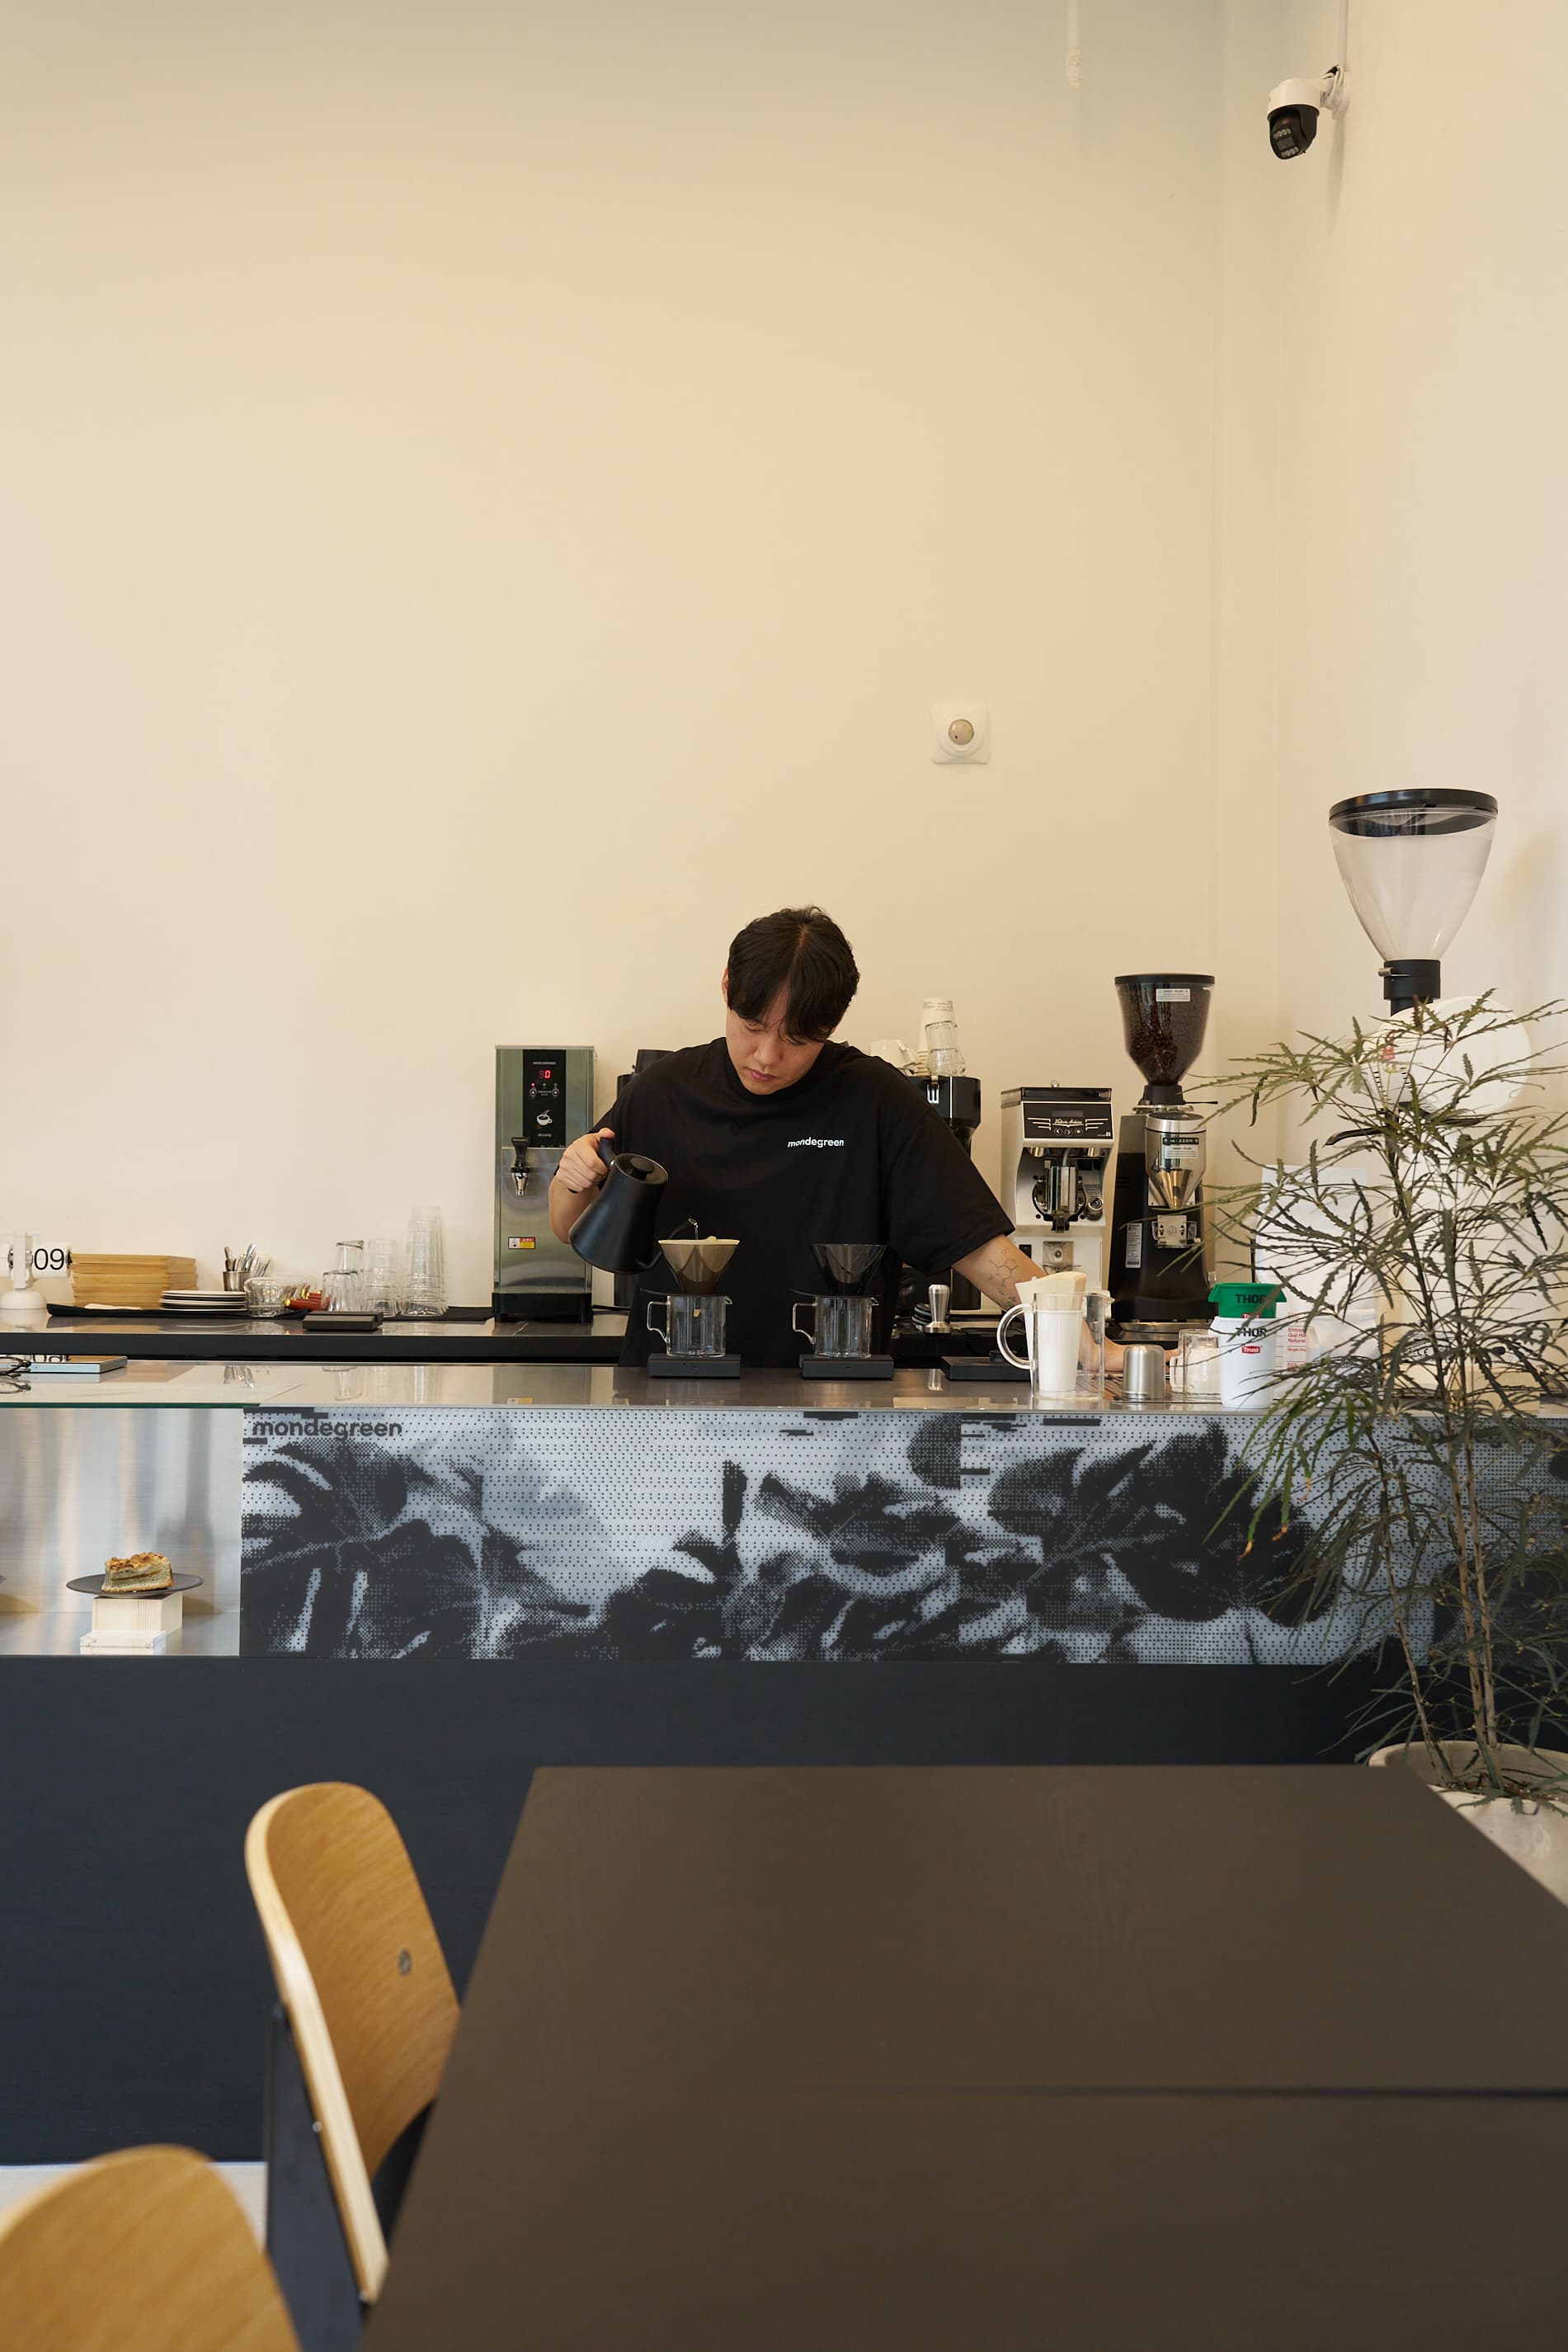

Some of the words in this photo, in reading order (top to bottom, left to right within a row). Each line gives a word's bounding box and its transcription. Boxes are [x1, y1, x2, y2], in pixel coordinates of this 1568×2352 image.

[787, 1136, 845, 1148] mondegreen
[34, 1247, 65, 1270] 09
[252, 1418, 403, 1442] mondegreen
